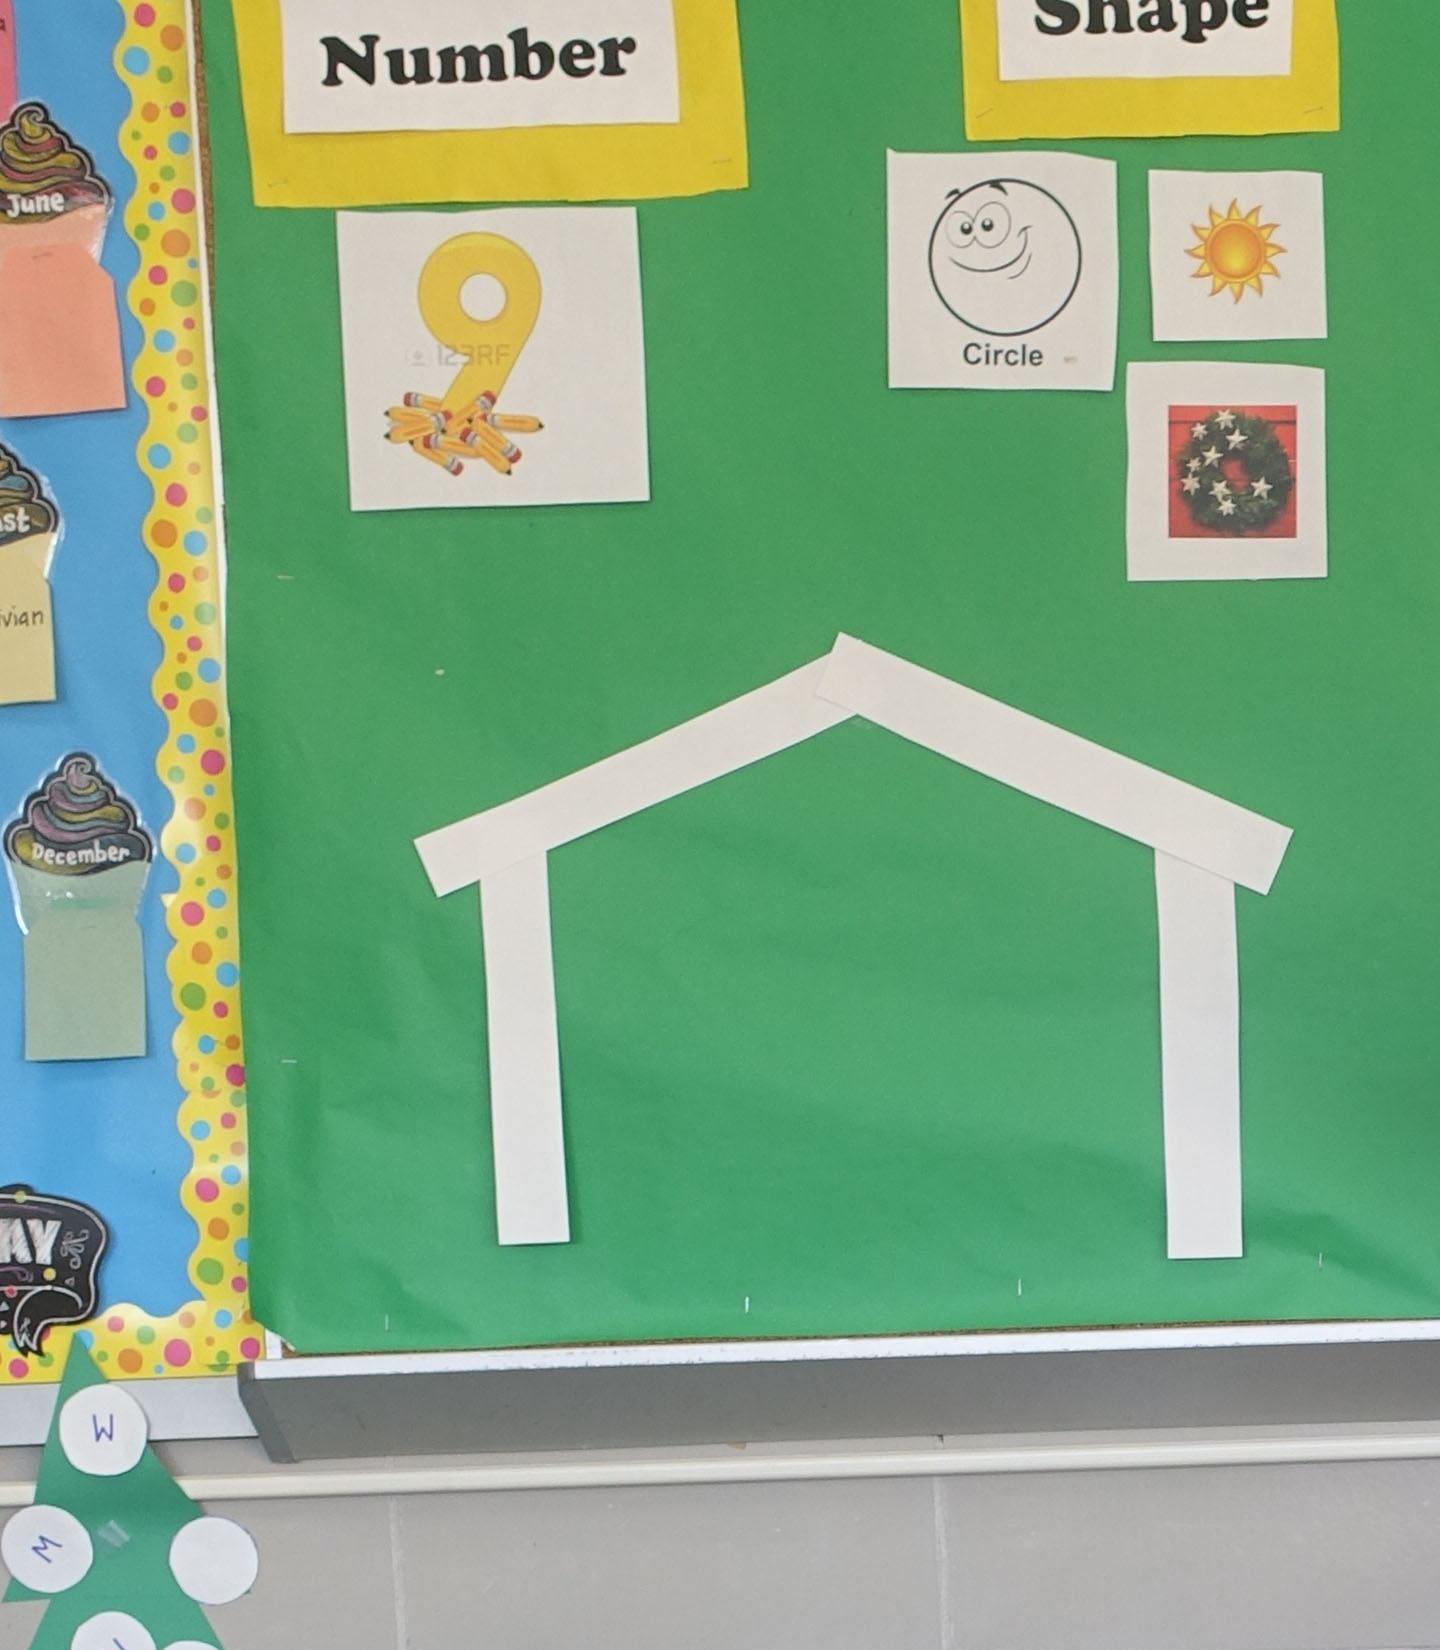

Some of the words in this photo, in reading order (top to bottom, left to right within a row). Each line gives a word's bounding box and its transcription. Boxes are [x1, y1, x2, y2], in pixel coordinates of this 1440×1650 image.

[320, 27, 638, 88] Number
[7, 192, 65, 218] June
[417, 231, 543, 458] 9
[962, 342, 1044, 369] Circle
[32, 840, 131, 866] December
